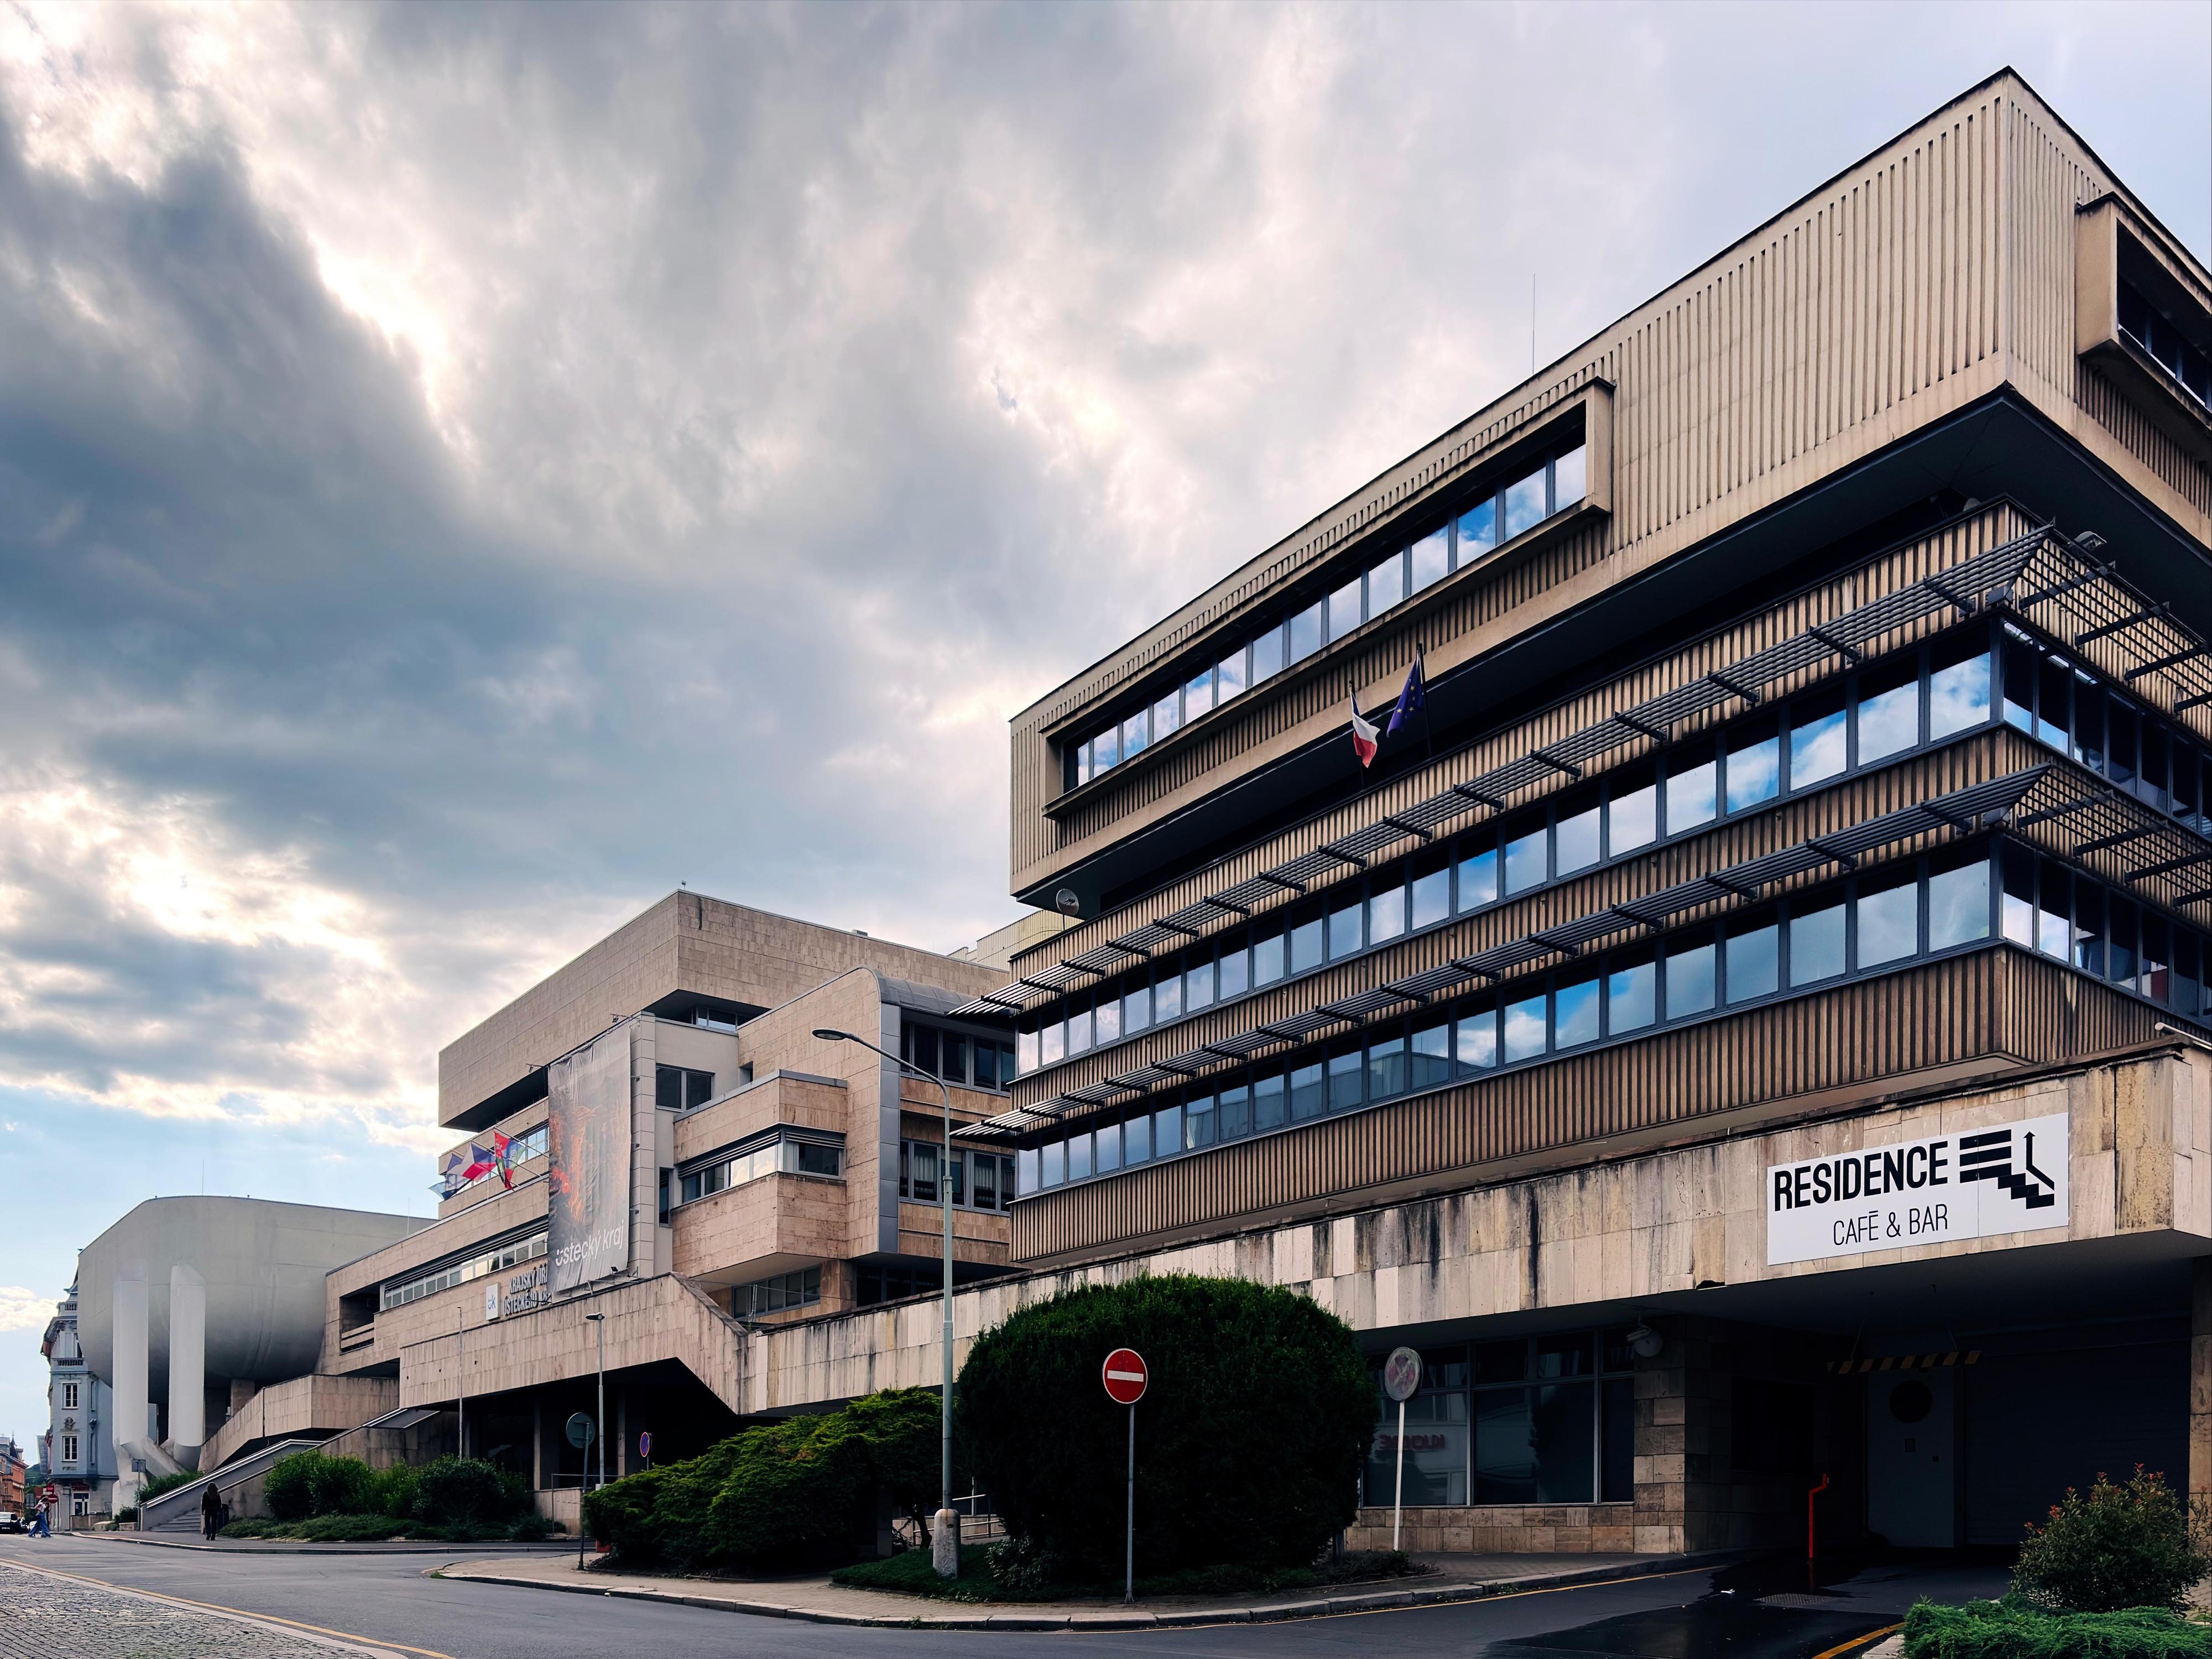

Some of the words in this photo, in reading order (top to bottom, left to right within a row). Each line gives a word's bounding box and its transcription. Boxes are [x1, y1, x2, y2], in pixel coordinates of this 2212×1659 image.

[1774, 1141, 1948, 1212] RESIDENCE
[602, 1219, 624, 1251] kraj
[1886, 1212, 1901, 1238] &
[1909, 1203, 1948, 1235] BAR
[510, 1266, 536, 1294] KRAJSKÝ
